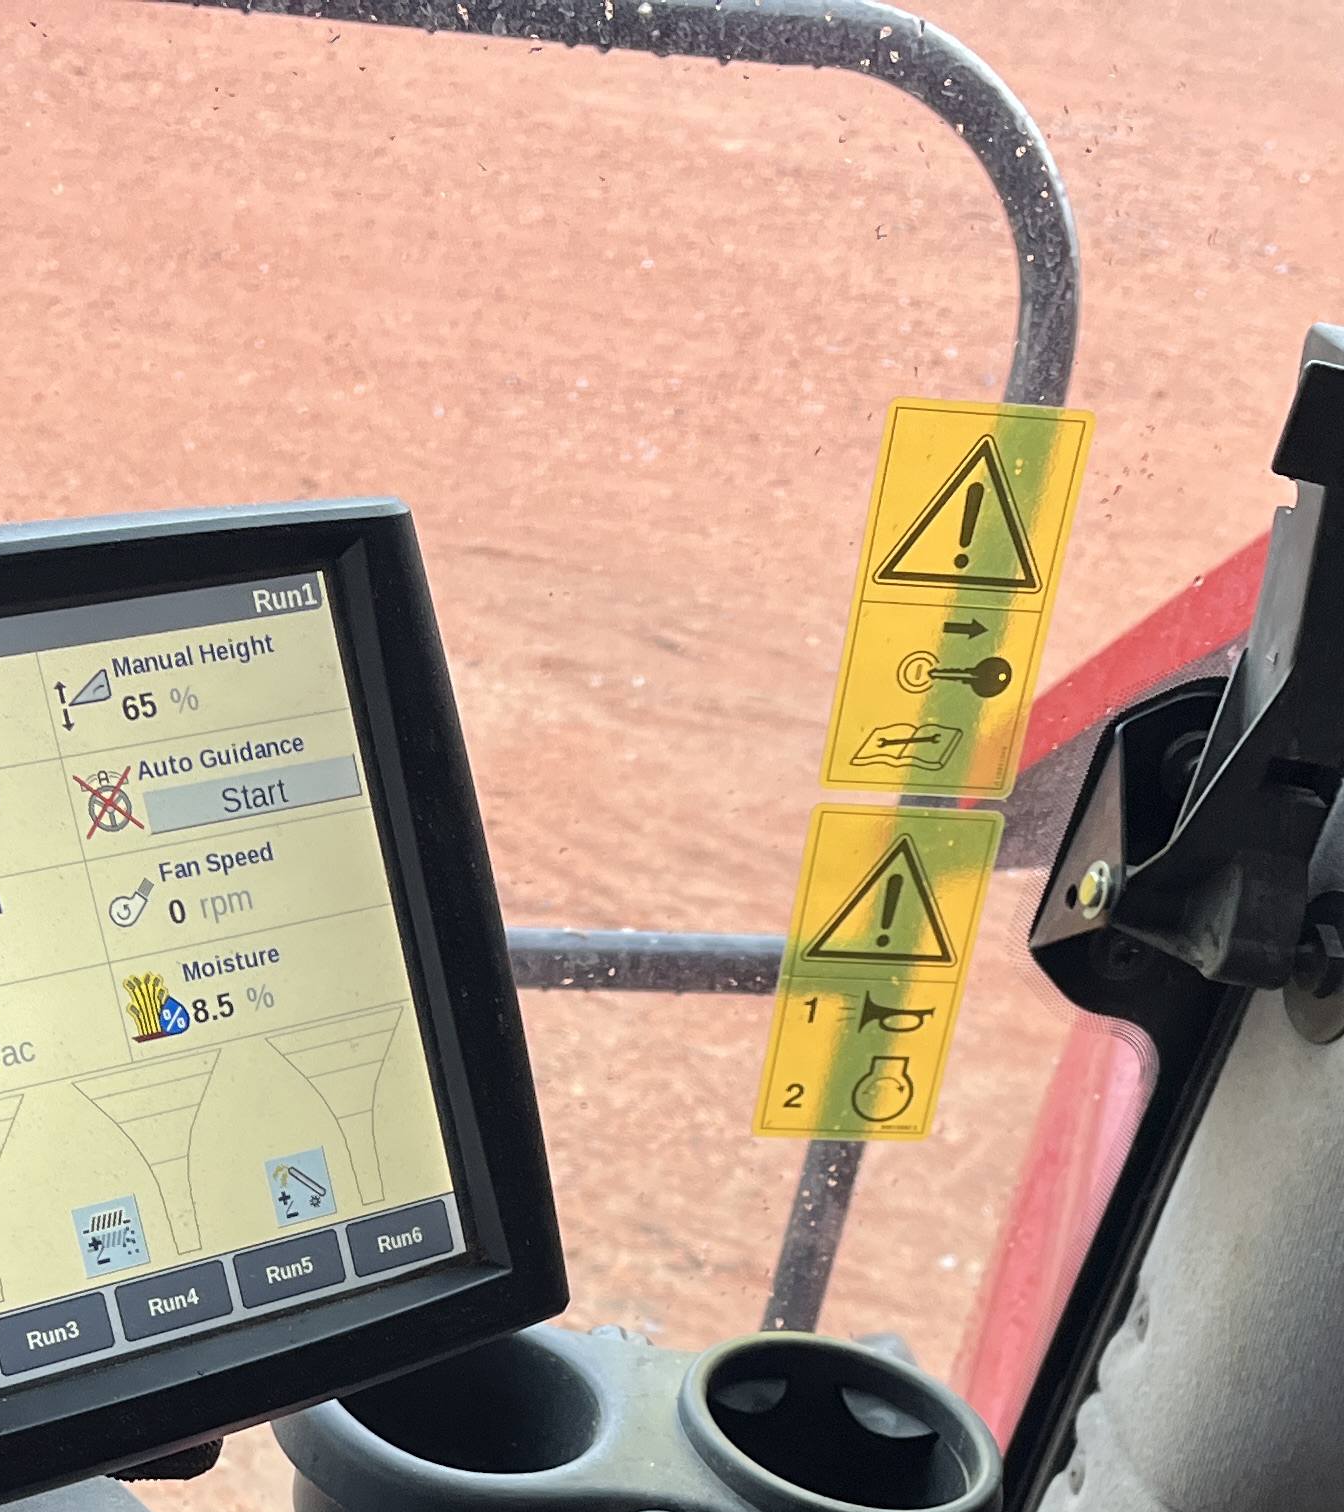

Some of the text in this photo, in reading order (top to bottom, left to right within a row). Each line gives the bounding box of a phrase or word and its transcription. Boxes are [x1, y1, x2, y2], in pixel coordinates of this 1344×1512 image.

[253, 583, 317, 613] Run1
[112, 634, 274, 678] Manual Height
[122, 686, 199, 721] 65 %
[138, 737, 304, 780] Auto Guidance
[222, 780, 289, 813] Start
[159, 842, 274, 882] Fan Speed
[168, 890, 254, 924] 0 rpm
[182, 948, 280, 982] Moisture
[191, 984, 275, 1023] 8.5 %
[804, 997, 818, 1023] 1
[783, 1084, 804, 1108] 2
[376, 1226, 423, 1253] Run6
[266, 1256, 314, 1284] Run5
[148, 1287, 200, 1315] Run4
[26, 1321, 80, 1350] Run3
